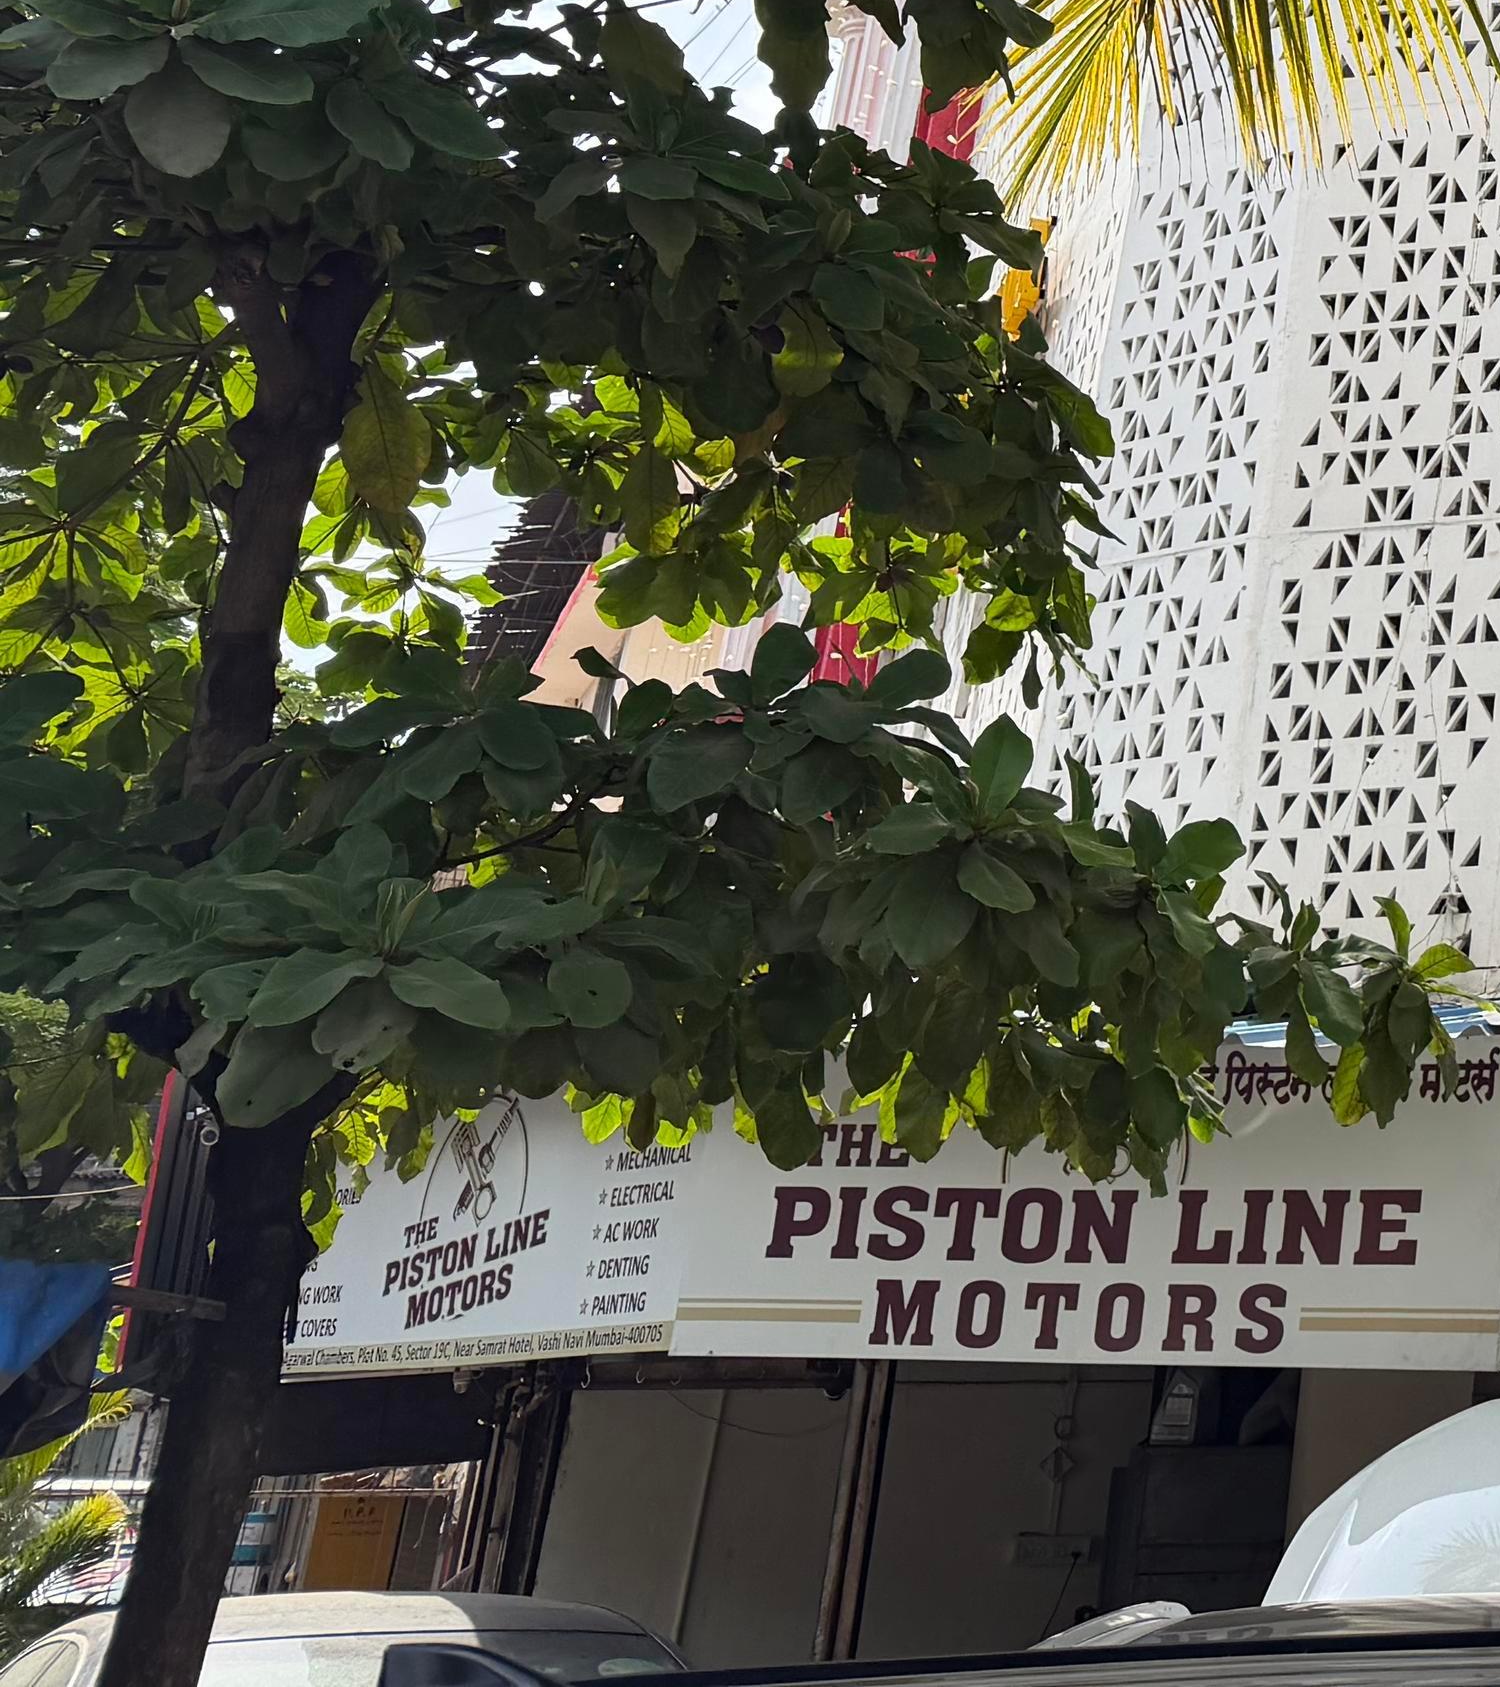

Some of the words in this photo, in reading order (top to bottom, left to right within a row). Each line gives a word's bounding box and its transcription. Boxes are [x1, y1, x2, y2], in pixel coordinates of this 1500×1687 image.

[616, 1143, 691, 1172] MECHANICAL
[610, 1180, 674, 1207] ELECTRICAL
[404, 1216, 440, 1249] THE
[603, 1222, 621, 1243] AC
[622, 1217, 660, 1242] WORK
[765, 1186, 1139, 1265] PISTON
[1171, 1189, 1423, 1266] LINE
[382, 1233, 478, 1297] PISTON
[484, 1208, 550, 1263] LINE
[597, 1255, 650, 1279] DENTING
[312, 1285, 343, 1305] WORK
[404, 1263, 513, 1330] MOTORS
[591, 1291, 647, 1316] PAINTING
[300, 1318, 338, 1338] COVERS
[868, 1279, 1287, 1354] MOTORS
[405, 1341, 432, 1361] Sector
[453, 1338, 474, 1358] Near
[475, 1338, 506, 1358] Samrat
[537, 1331, 562, 1352] Vashi
[563, 1329, 584, 1349] Navi
[585, 1323, 663, 1348] Mumbai-400705
